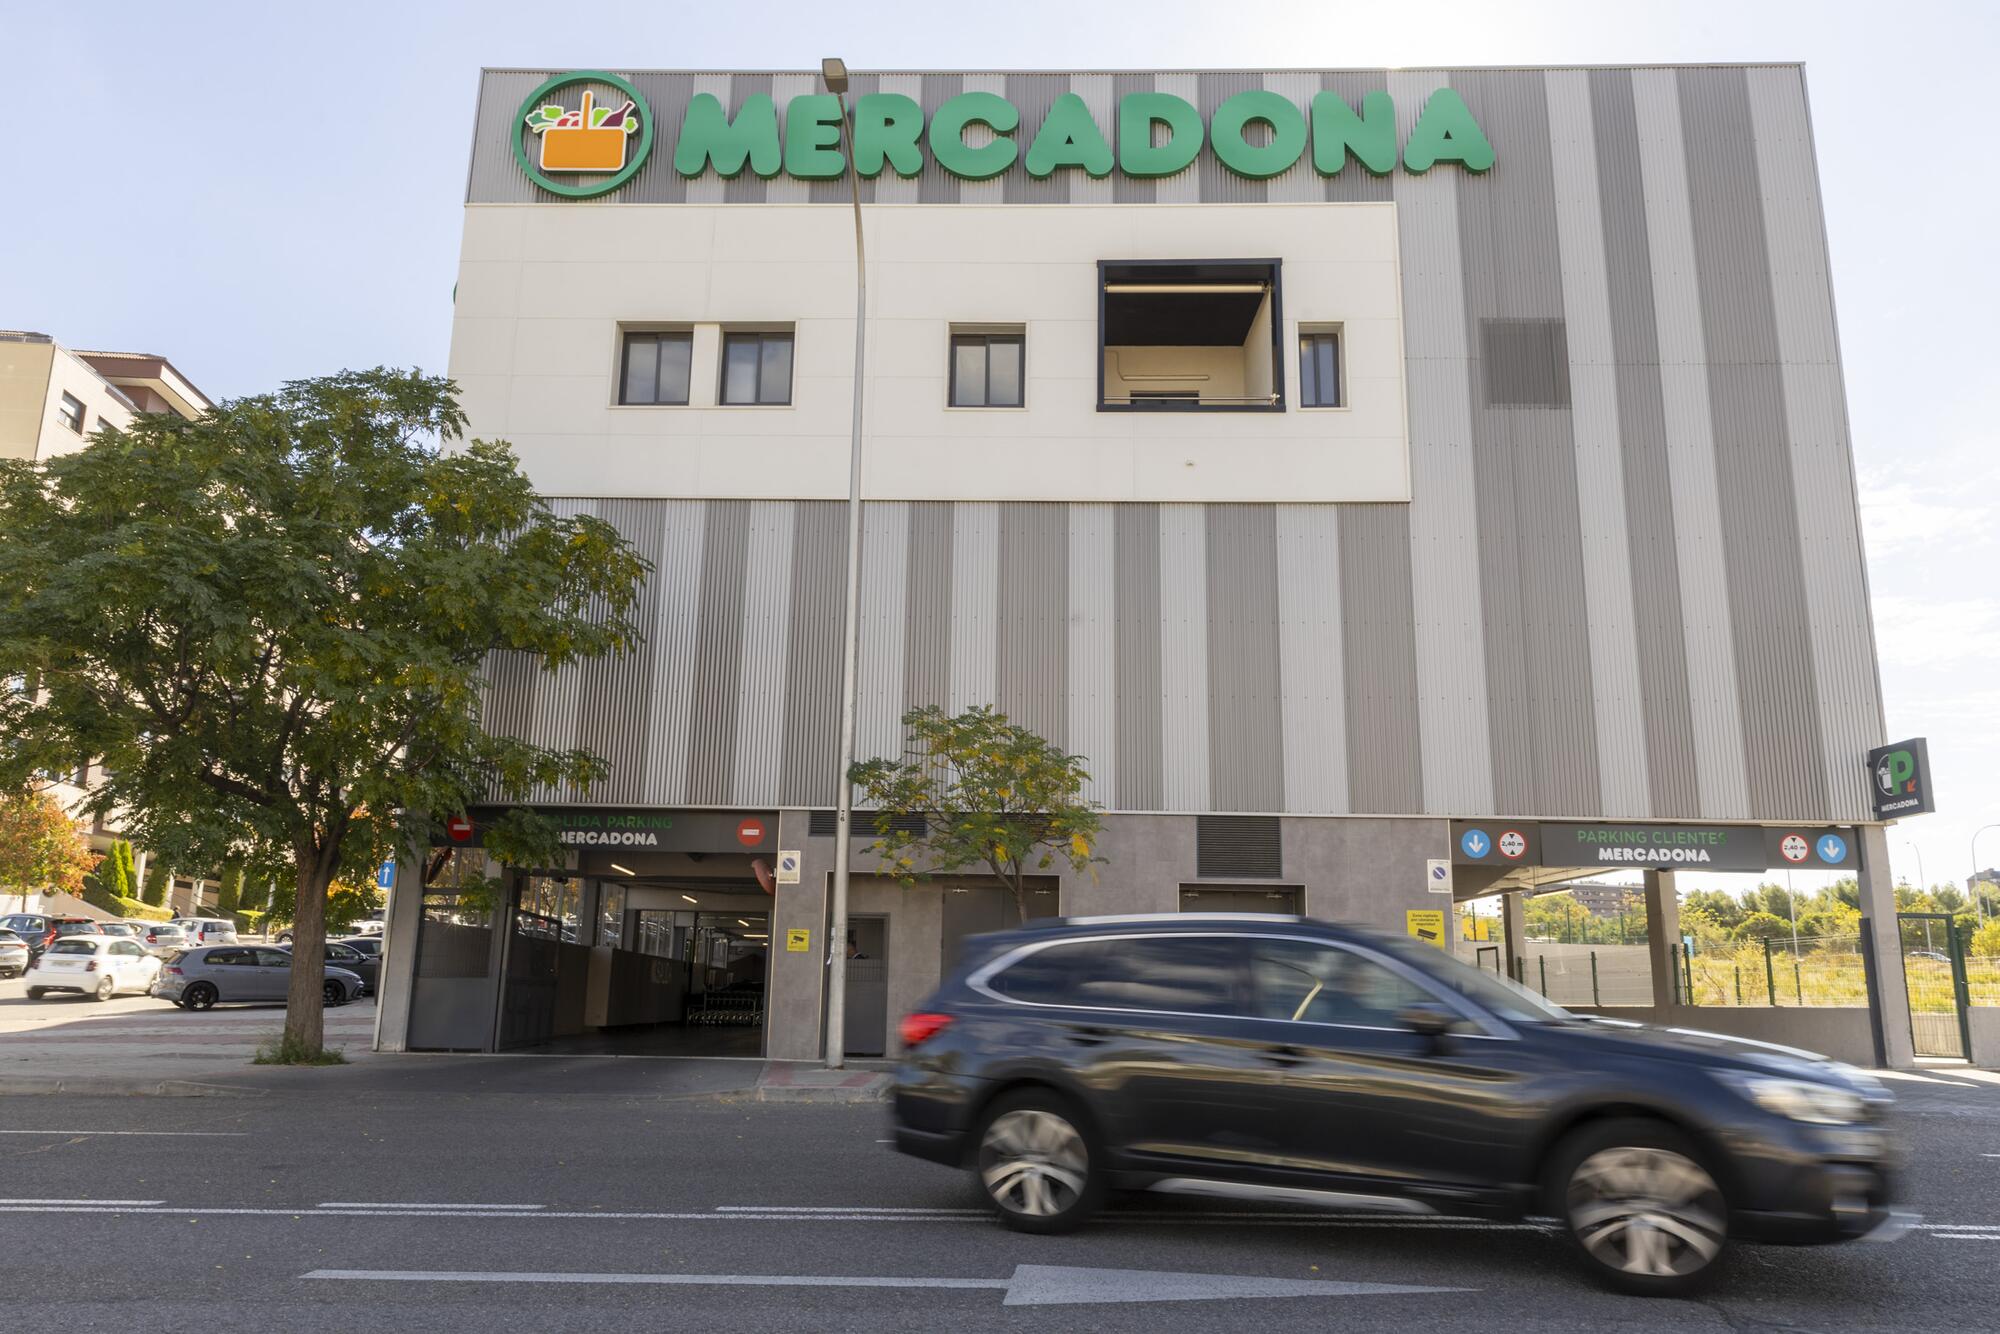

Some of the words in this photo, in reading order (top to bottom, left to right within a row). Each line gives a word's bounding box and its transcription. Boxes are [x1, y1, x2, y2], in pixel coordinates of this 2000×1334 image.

[674, 89, 1494, 180] MERCADONA
[1881, 798, 1919, 812] MERCADONA
[607, 815, 673, 829] PARKING
[1577, 830, 1647, 844] PARKING
[1652, 831, 1727, 846] CLIENTES
[1598, 847, 1711, 862] MERCADONA
